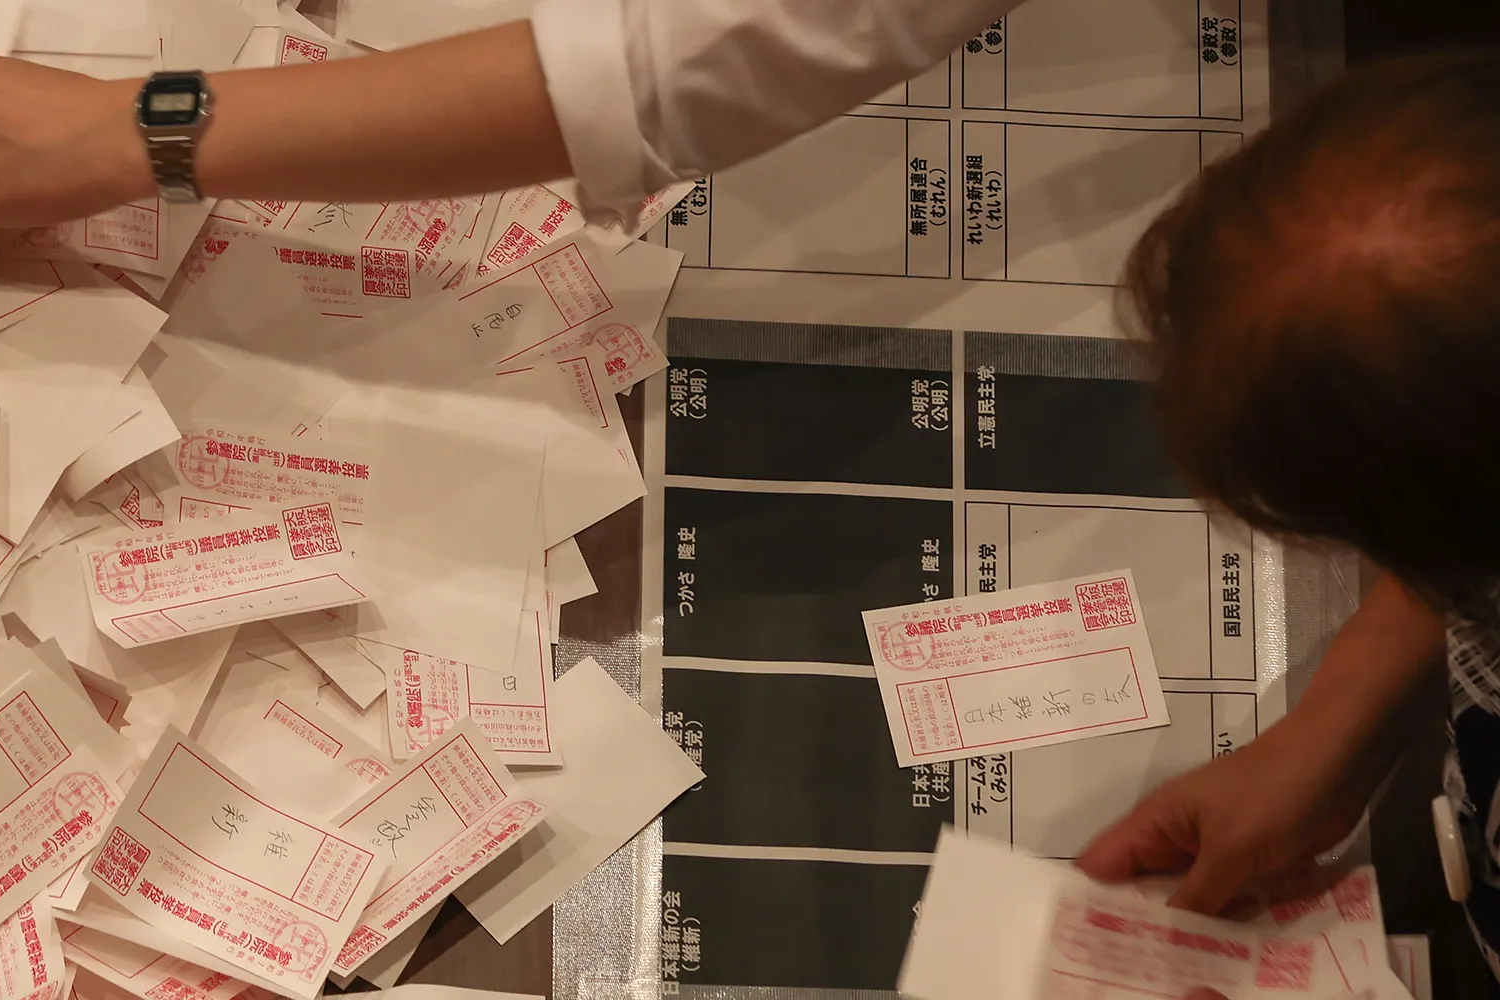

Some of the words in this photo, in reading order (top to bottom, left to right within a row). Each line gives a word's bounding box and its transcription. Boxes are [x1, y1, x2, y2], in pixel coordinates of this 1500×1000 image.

[1201, 17, 1218, 63] 参政党
[1220, 18, 1236, 65] （参政）
[910, 156, 927, 235] 無所属連合
[930, 168, 946, 226] （むれん）
[966, 154, 982, 244] れいわ新選組
[985, 170, 1002, 230] （れいわ）
[671, 368, 688, 416] 公明党
[690, 367, 707, 418] （公明）
[911, 378, 929, 428] 公明党
[931, 379, 948, 430] （公明）
[976, 366, 999, 449] 立憲民主党
[118, 520, 280, 570] 参議院（比例代表選出）議員選挙投票
[677, 526, 696, 559] 隆史
[922, 538, 939, 570] 隆史
[979, 543, 995, 592] 民主党
[678, 571, 694, 616] つかさ
[1222, 552, 1241, 636] 国民民主党
[961, 671, 1135, 735] 日本維新の会
[684, 719, 702, 791] （産党）
[971, 755, 987, 814] チームみ
[206, 799, 295, 865] 維新
[663, 891, 680, 995] 日本維新の会
[683, 916, 701, 971] （維新）
